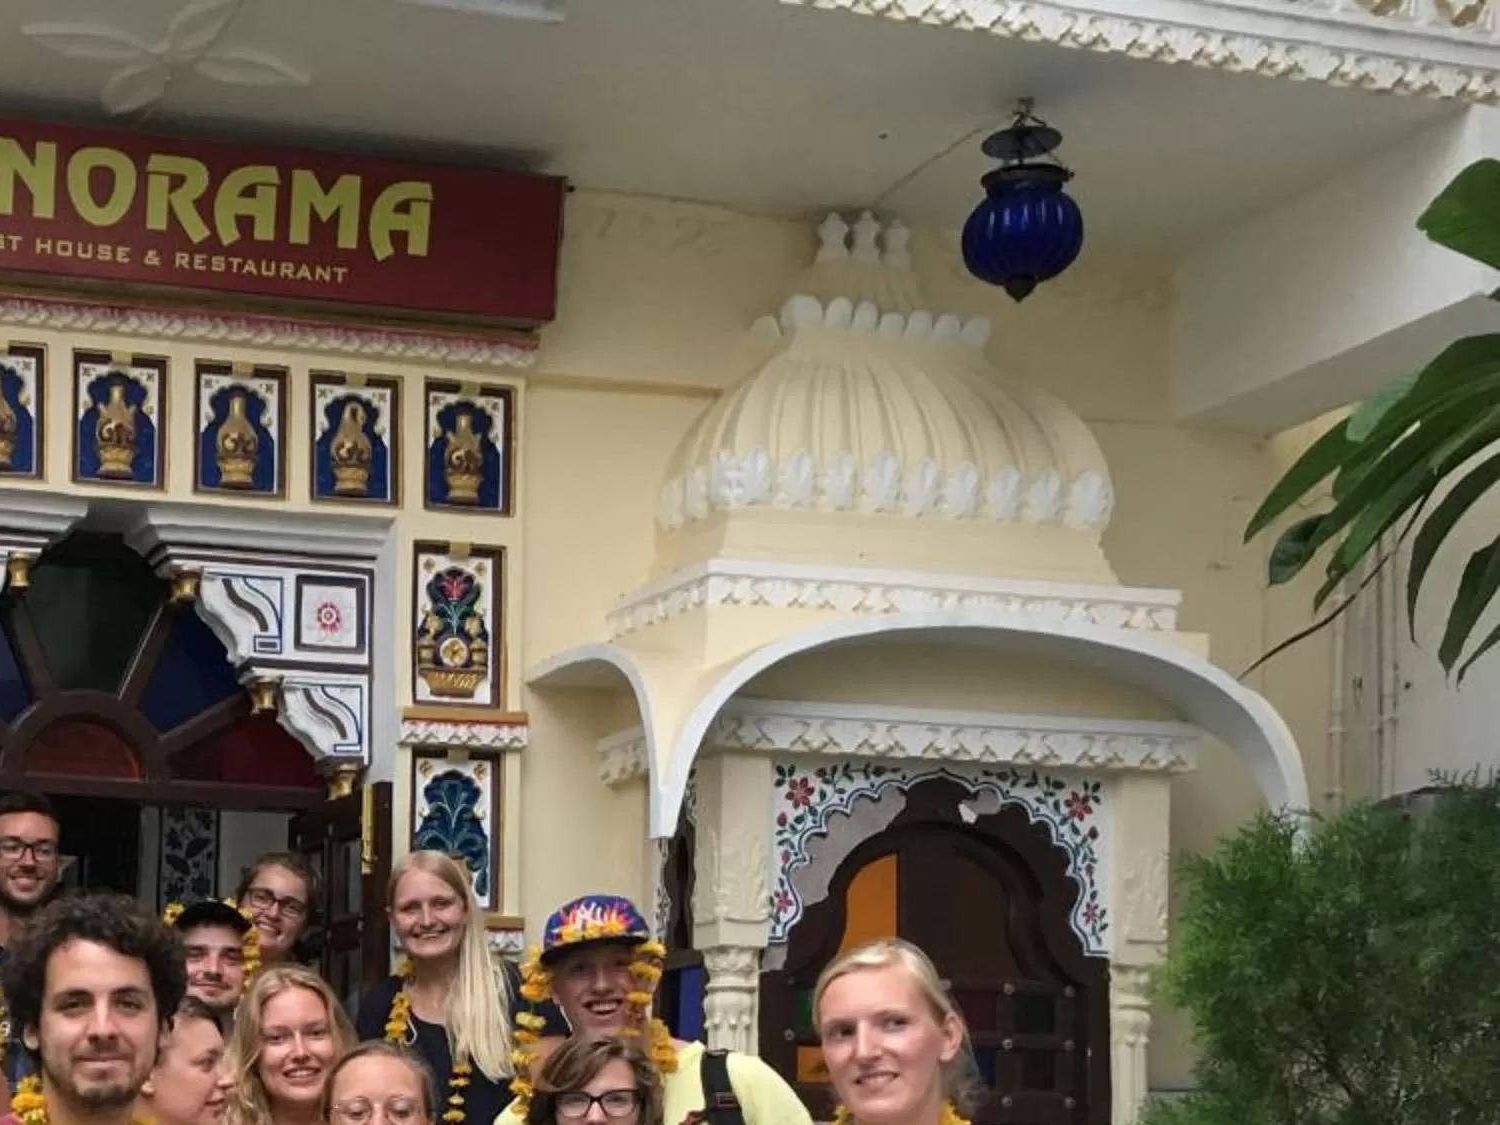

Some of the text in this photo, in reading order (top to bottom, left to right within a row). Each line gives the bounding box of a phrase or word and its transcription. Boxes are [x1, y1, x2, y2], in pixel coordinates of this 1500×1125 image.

[35, 238, 132, 264] HOUSE
[143, 249, 161, 267] &
[174, 251, 349, 284] RESTAURANT
